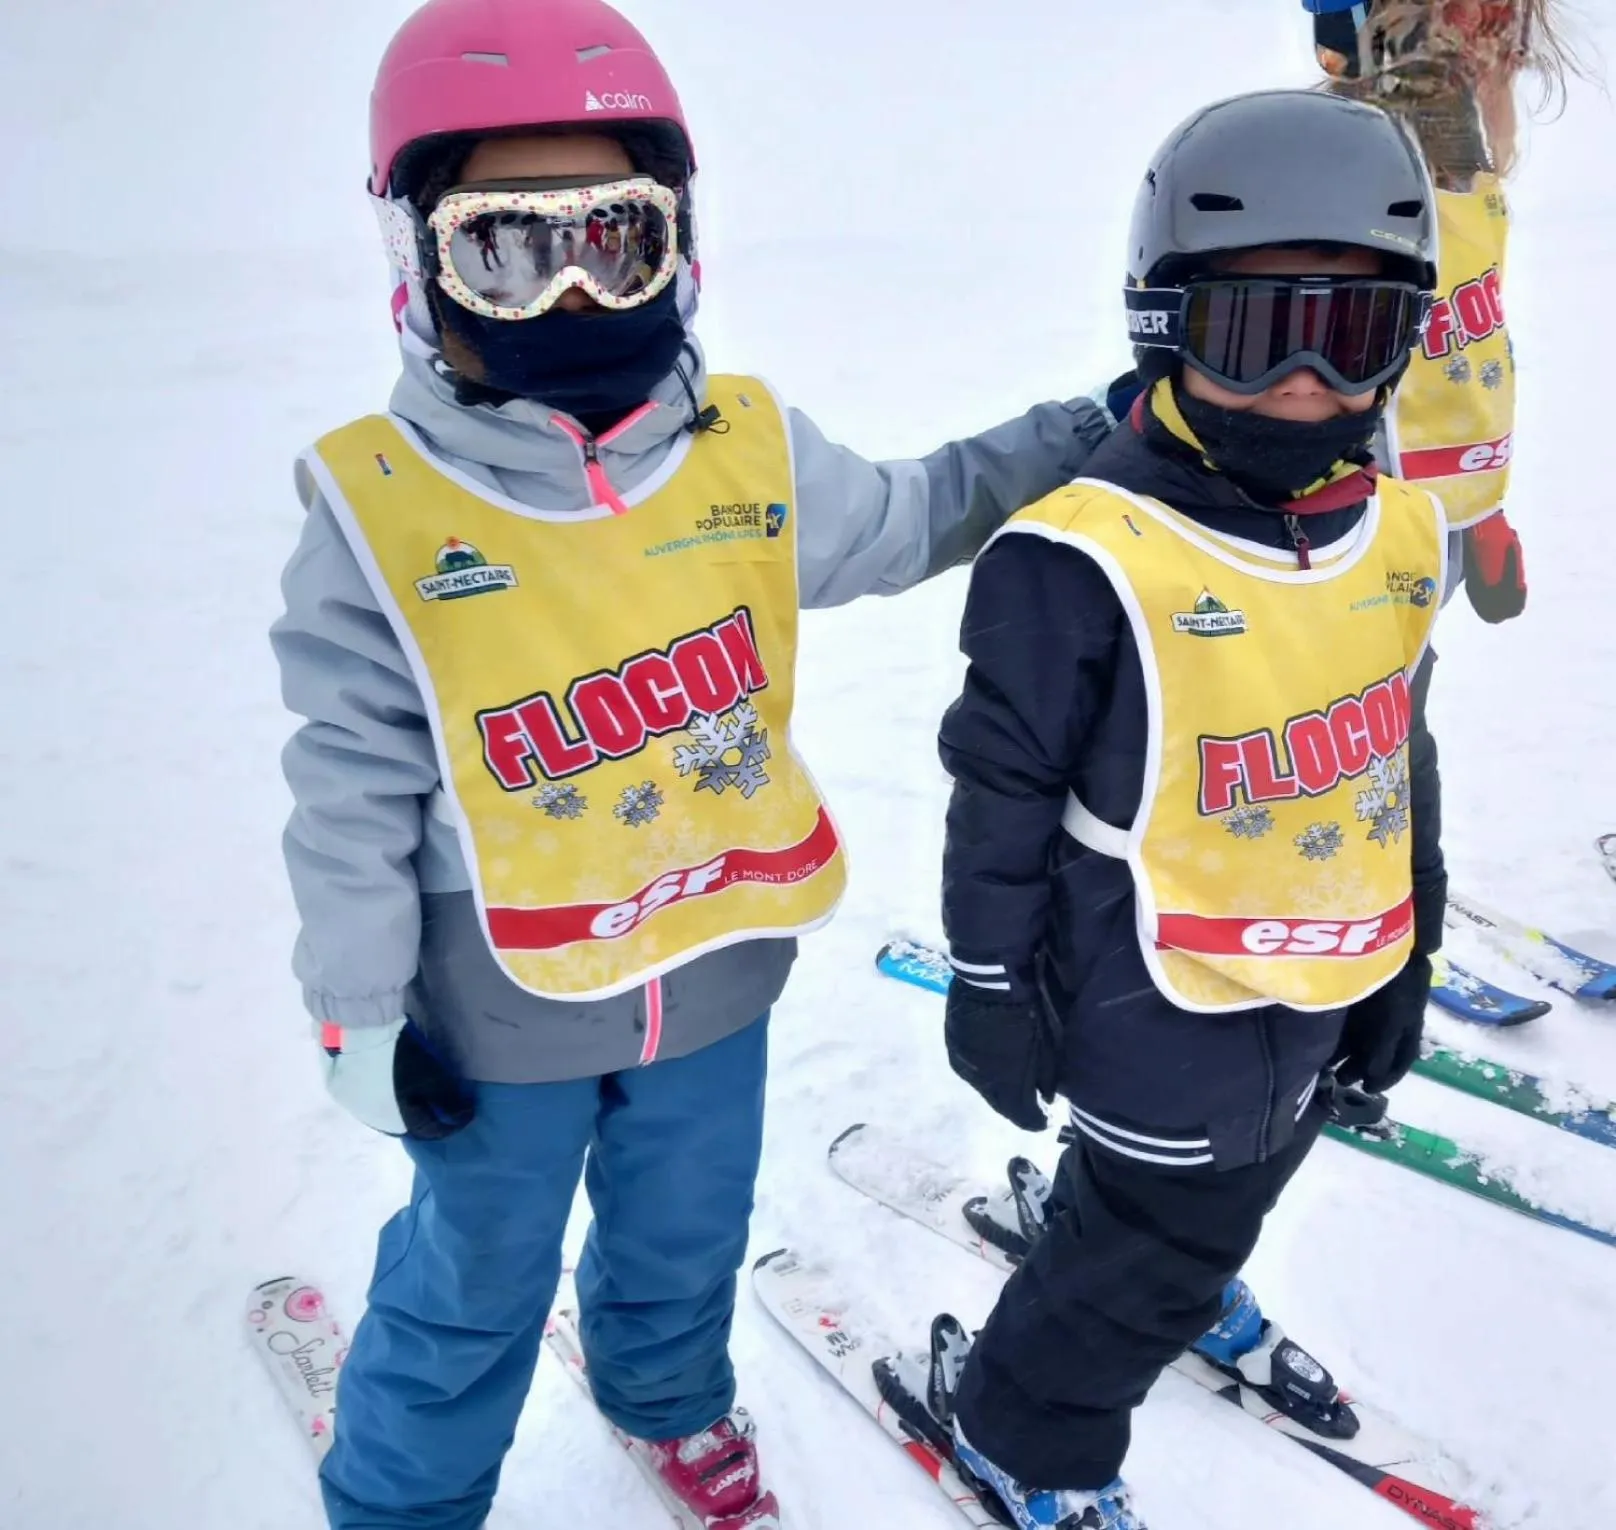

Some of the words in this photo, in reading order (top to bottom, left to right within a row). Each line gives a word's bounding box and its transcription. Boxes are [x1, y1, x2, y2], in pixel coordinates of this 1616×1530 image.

[475, 604, 768, 791] FLOCON
[724, 872, 738, 885] LE
[743, 871, 782, 882] MONT
[787, 859, 818, 881] DORE
